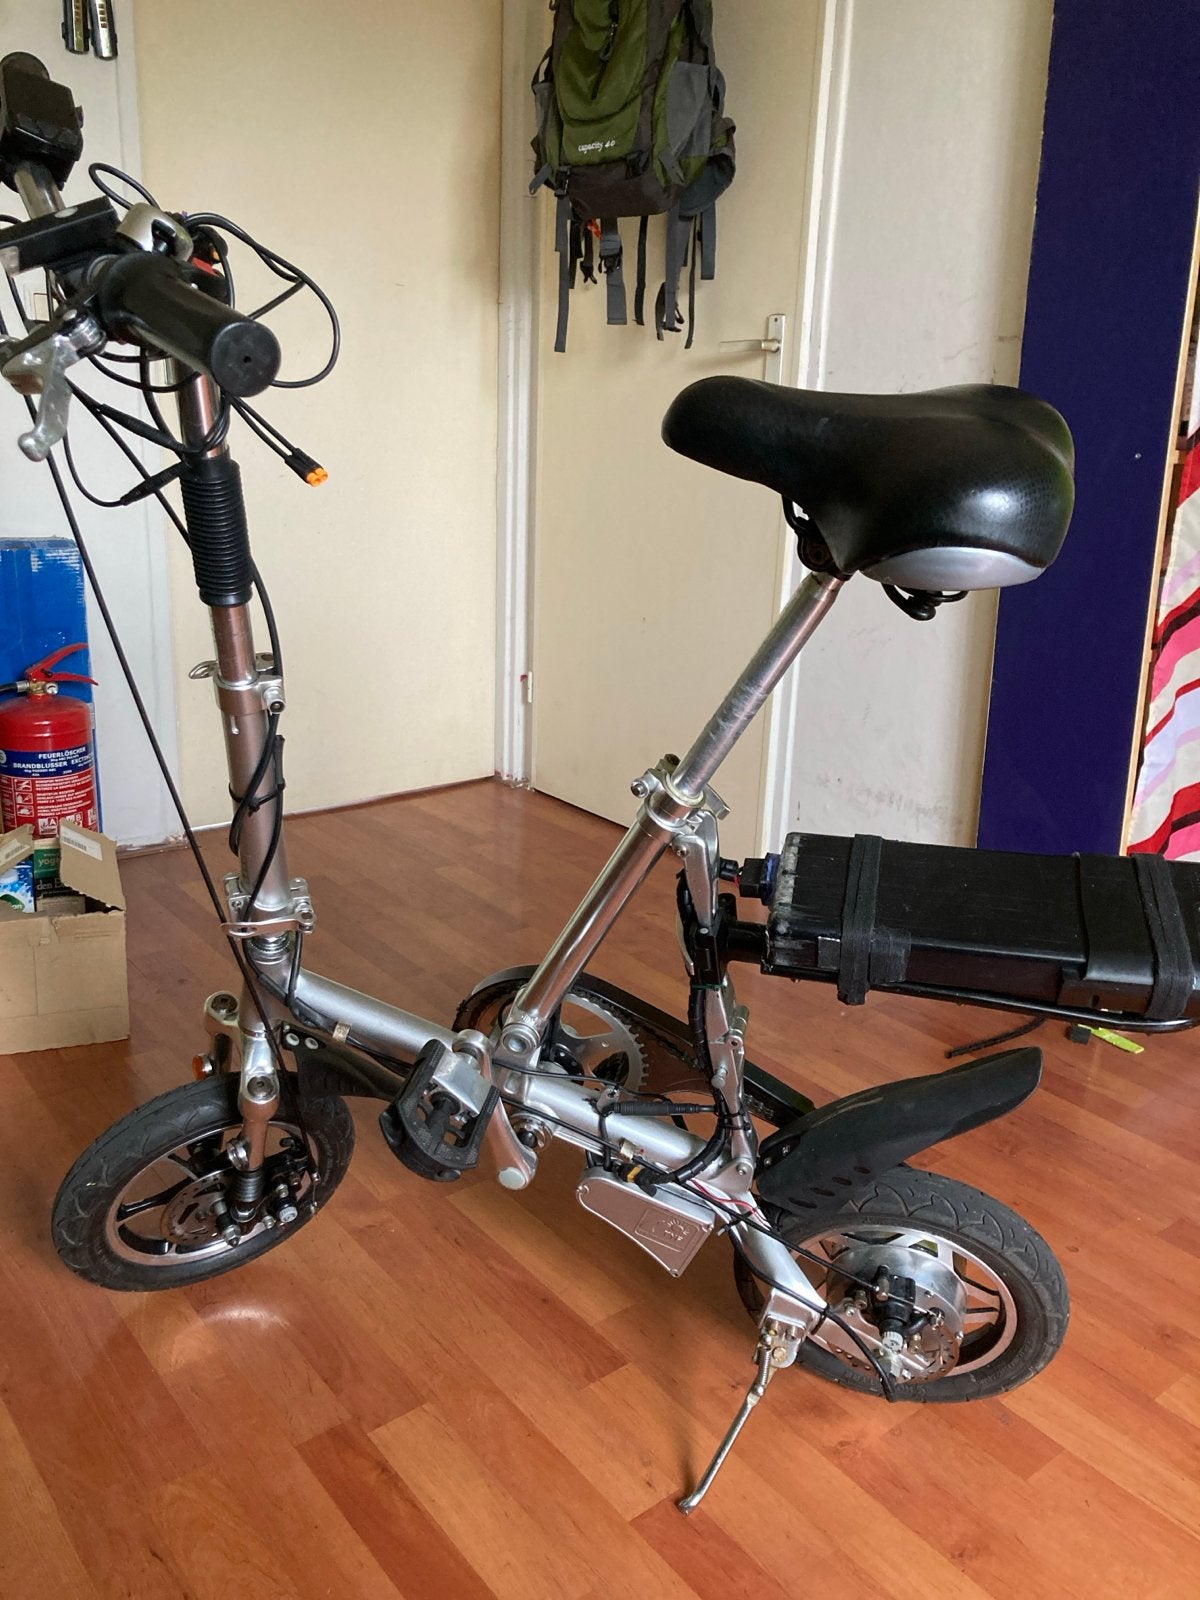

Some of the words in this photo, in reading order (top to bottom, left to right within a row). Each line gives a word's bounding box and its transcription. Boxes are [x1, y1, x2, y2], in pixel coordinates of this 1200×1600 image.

[578, 141, 603, 154] capacity
[604, 139, 616, 148] 40
[38, 746, 86, 760] FEUERLÖSCHER
[13, 760, 68, 769] BRANDBLUSSER
